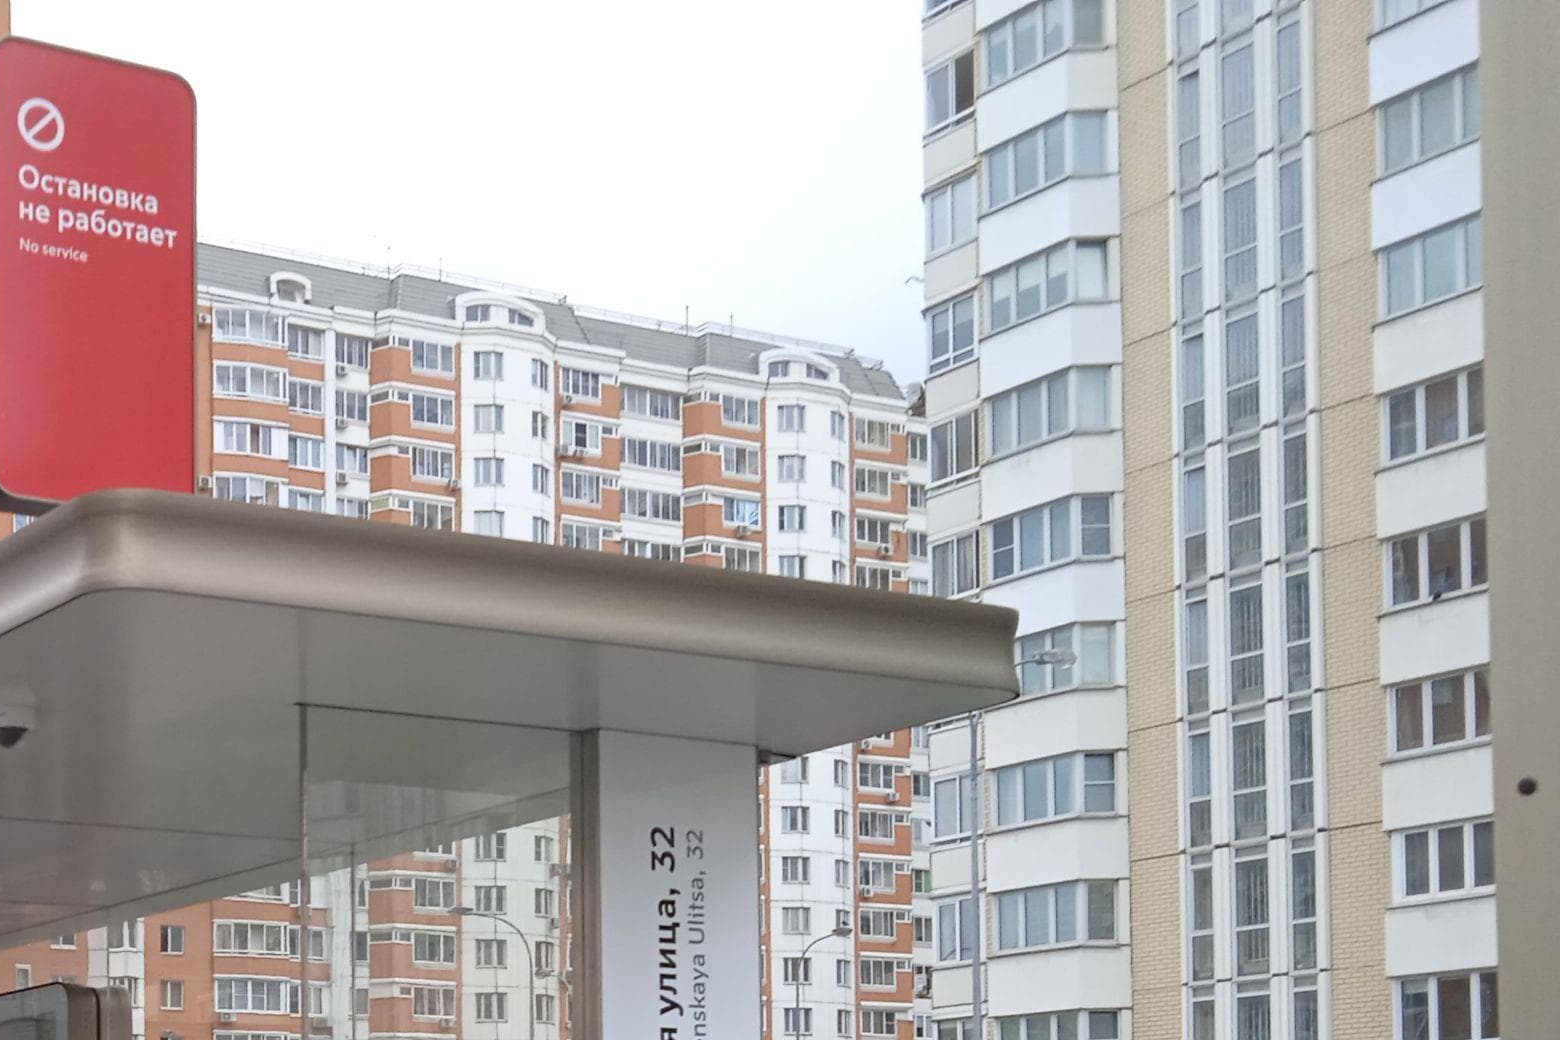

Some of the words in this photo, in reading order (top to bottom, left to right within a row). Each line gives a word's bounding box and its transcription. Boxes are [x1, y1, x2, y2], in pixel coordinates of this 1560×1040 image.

[18, 163, 159, 215] Остановка
[18, 200, 51, 224] не
[58, 207, 178, 249] работает
[19, 237, 39, 253] No
[42, 242, 88, 263] service
[650, 826, 676, 873] 32
[686, 829, 704, 860] 32
[688, 871, 707, 944] Ulitsa,
[657, 888, 684, 1017] улица,
